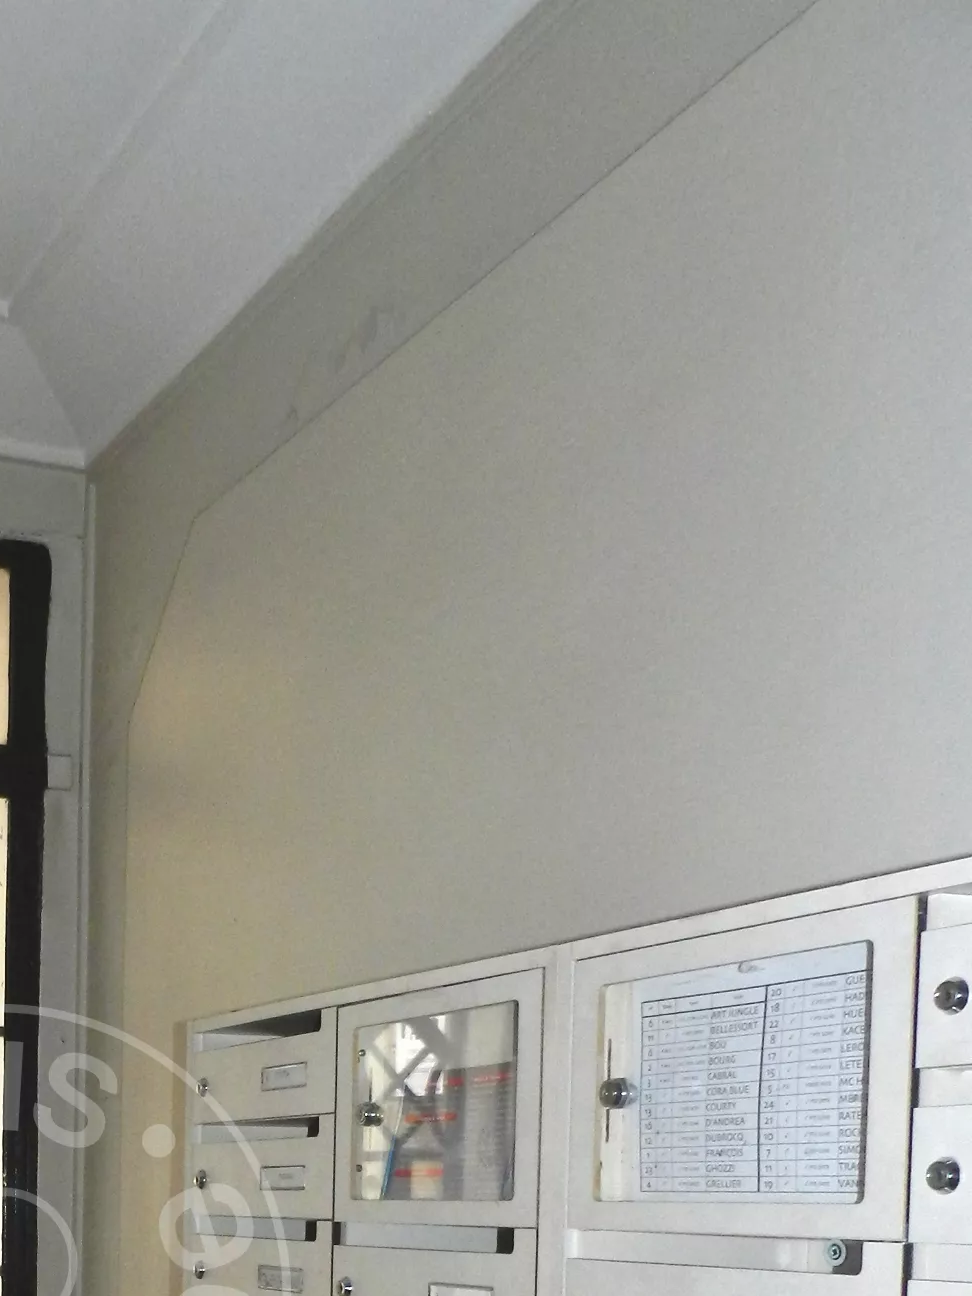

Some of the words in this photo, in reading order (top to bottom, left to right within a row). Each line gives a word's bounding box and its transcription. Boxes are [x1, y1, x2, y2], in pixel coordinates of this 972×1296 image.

[771, 988, 782, 996] 20
[769, 1020, 779, 1028] 22
[768, 1052, 776, 1060] 17
